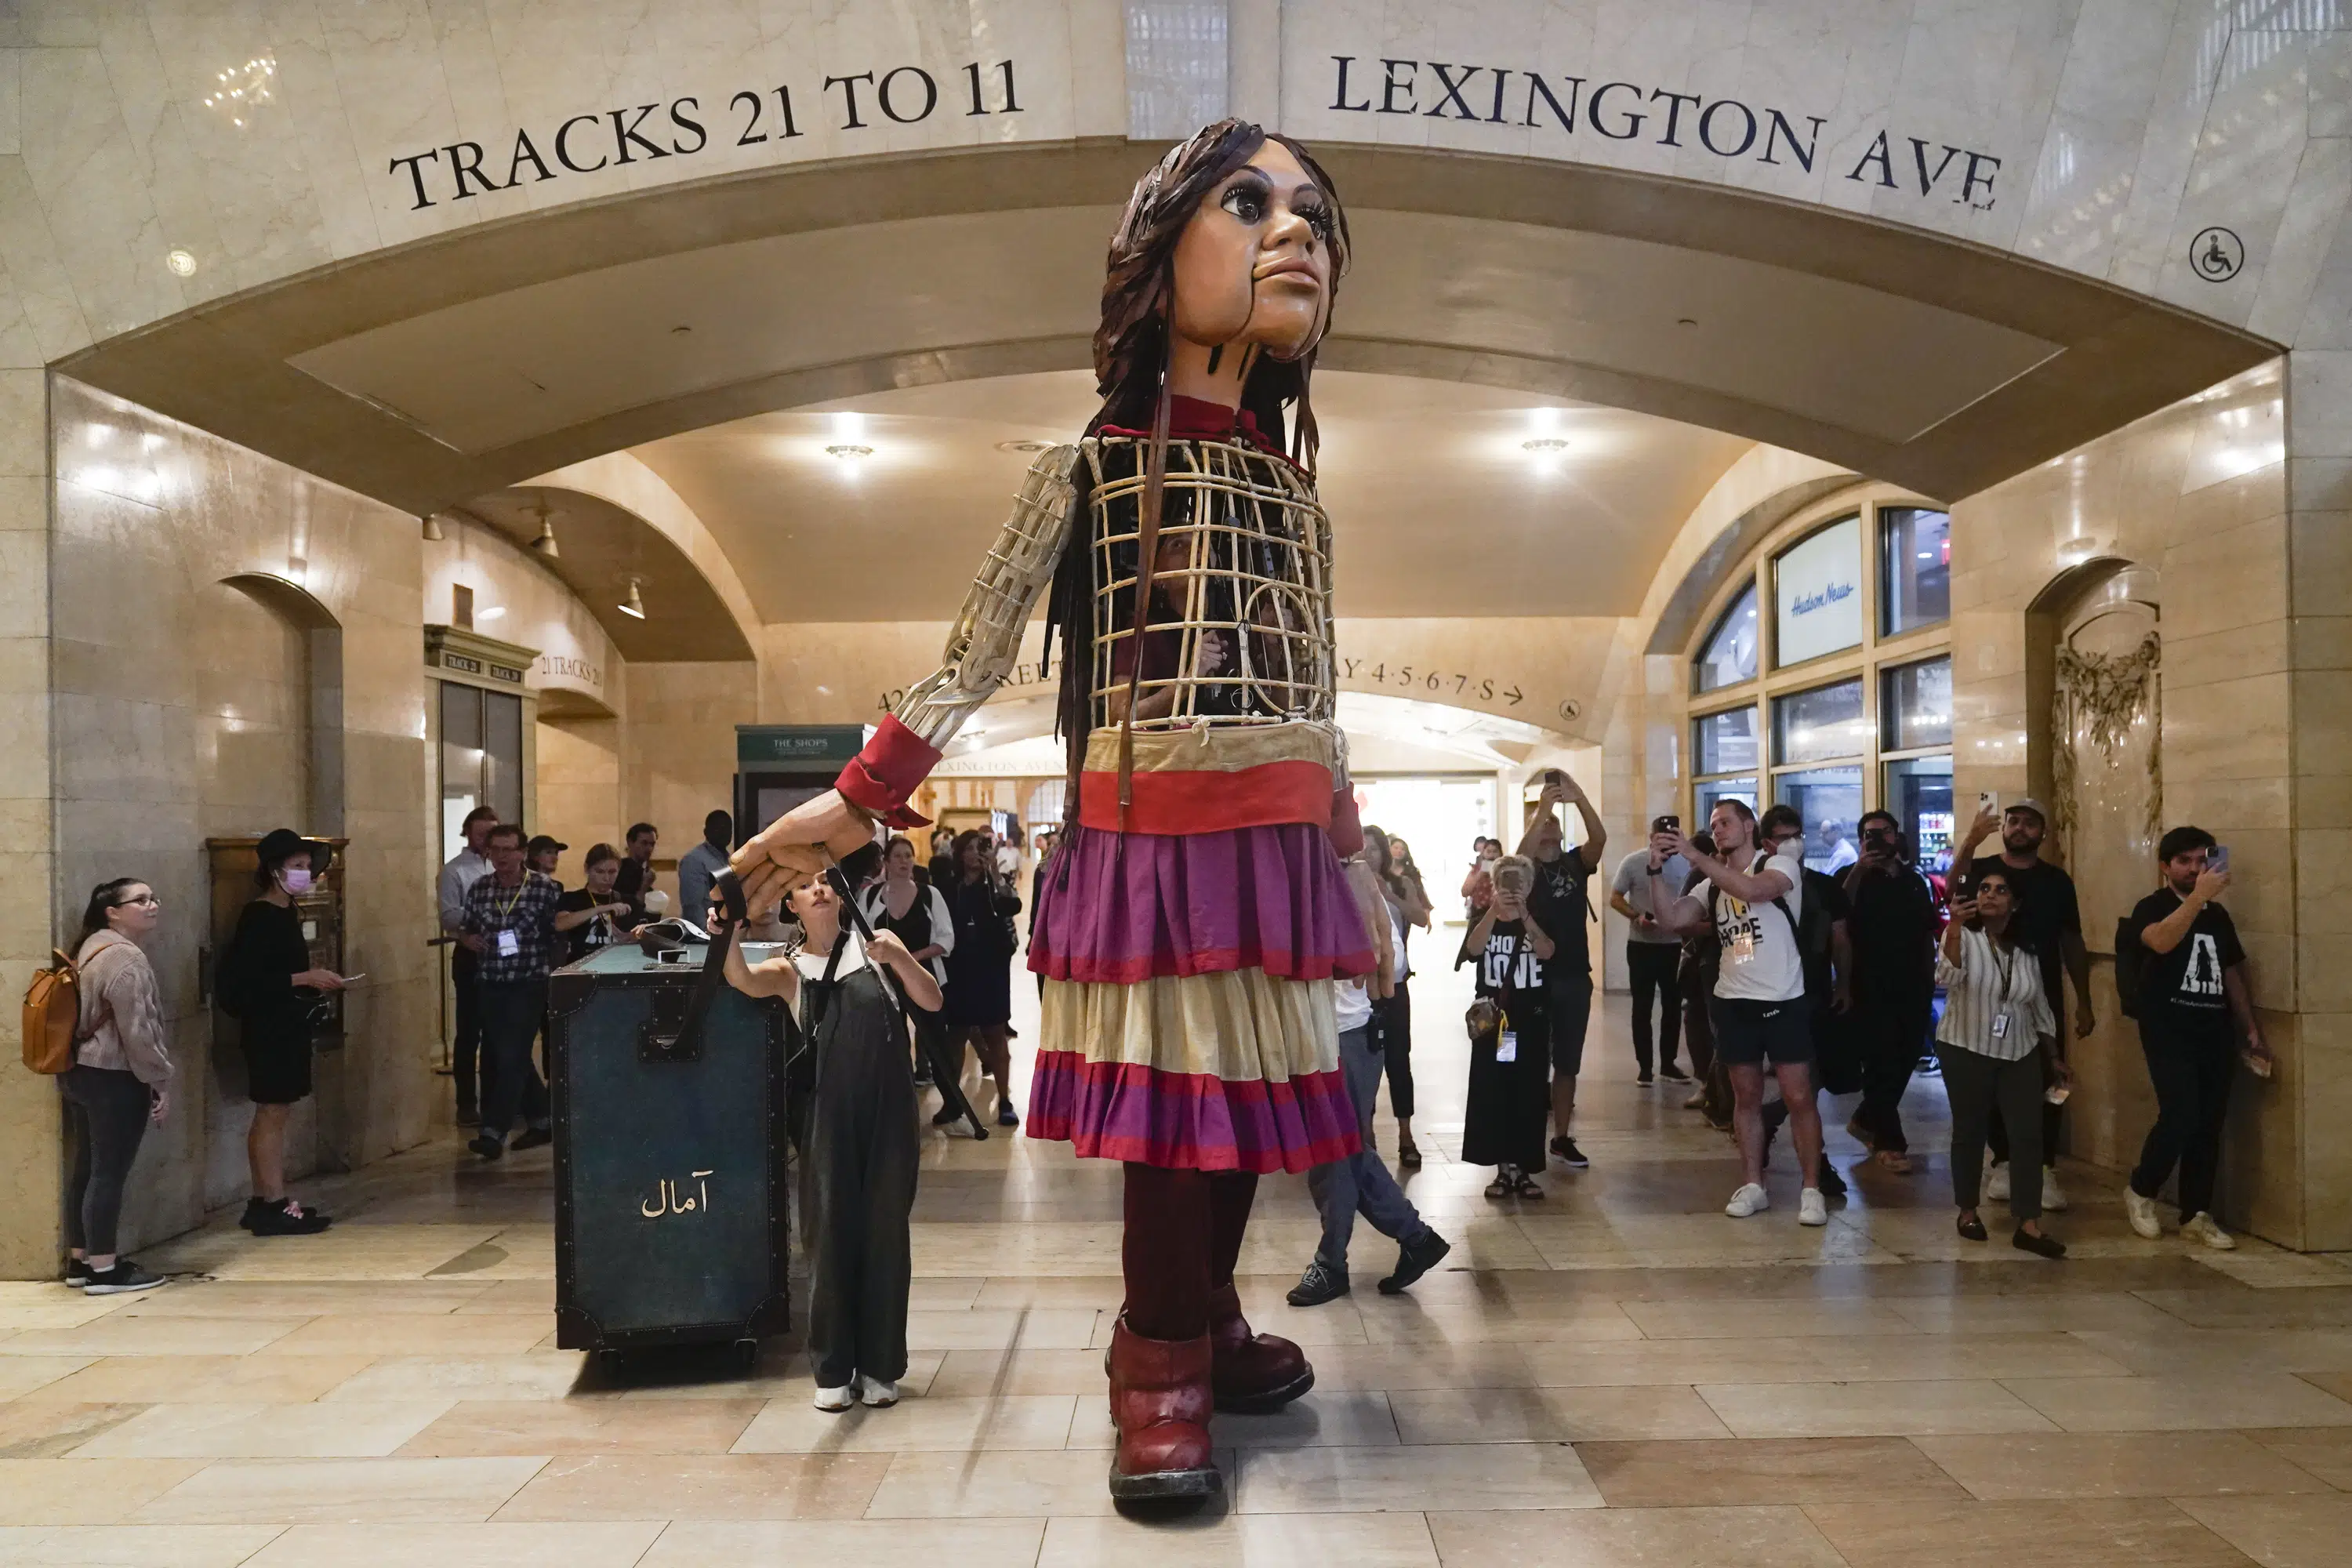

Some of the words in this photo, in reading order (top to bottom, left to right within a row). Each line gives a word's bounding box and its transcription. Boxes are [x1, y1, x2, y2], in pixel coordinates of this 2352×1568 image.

[390, 96, 707, 211] TRACKS
[730, 85, 804, 147] 21
[824, 66, 938, 130] TO
[961, 59, 1024, 117] 11
[1328, 56, 1828, 175] LEXINGTON
[1846, 129, 2002, 211] AVE
[1791, 591, 1824, 618] Hudson
[1825, 581, 1854, 605] News
[448, 655, 469, 670] TRACK
[542, 656, 551, 674] 21
[554, 656, 590, 682] TRACKS
[774, 739, 791, 747] THE
[795, 738, 828, 747] SHOPS
[1484, 950, 1542, 989] LOVE
[641, 1170, 714, 1218] آمال
